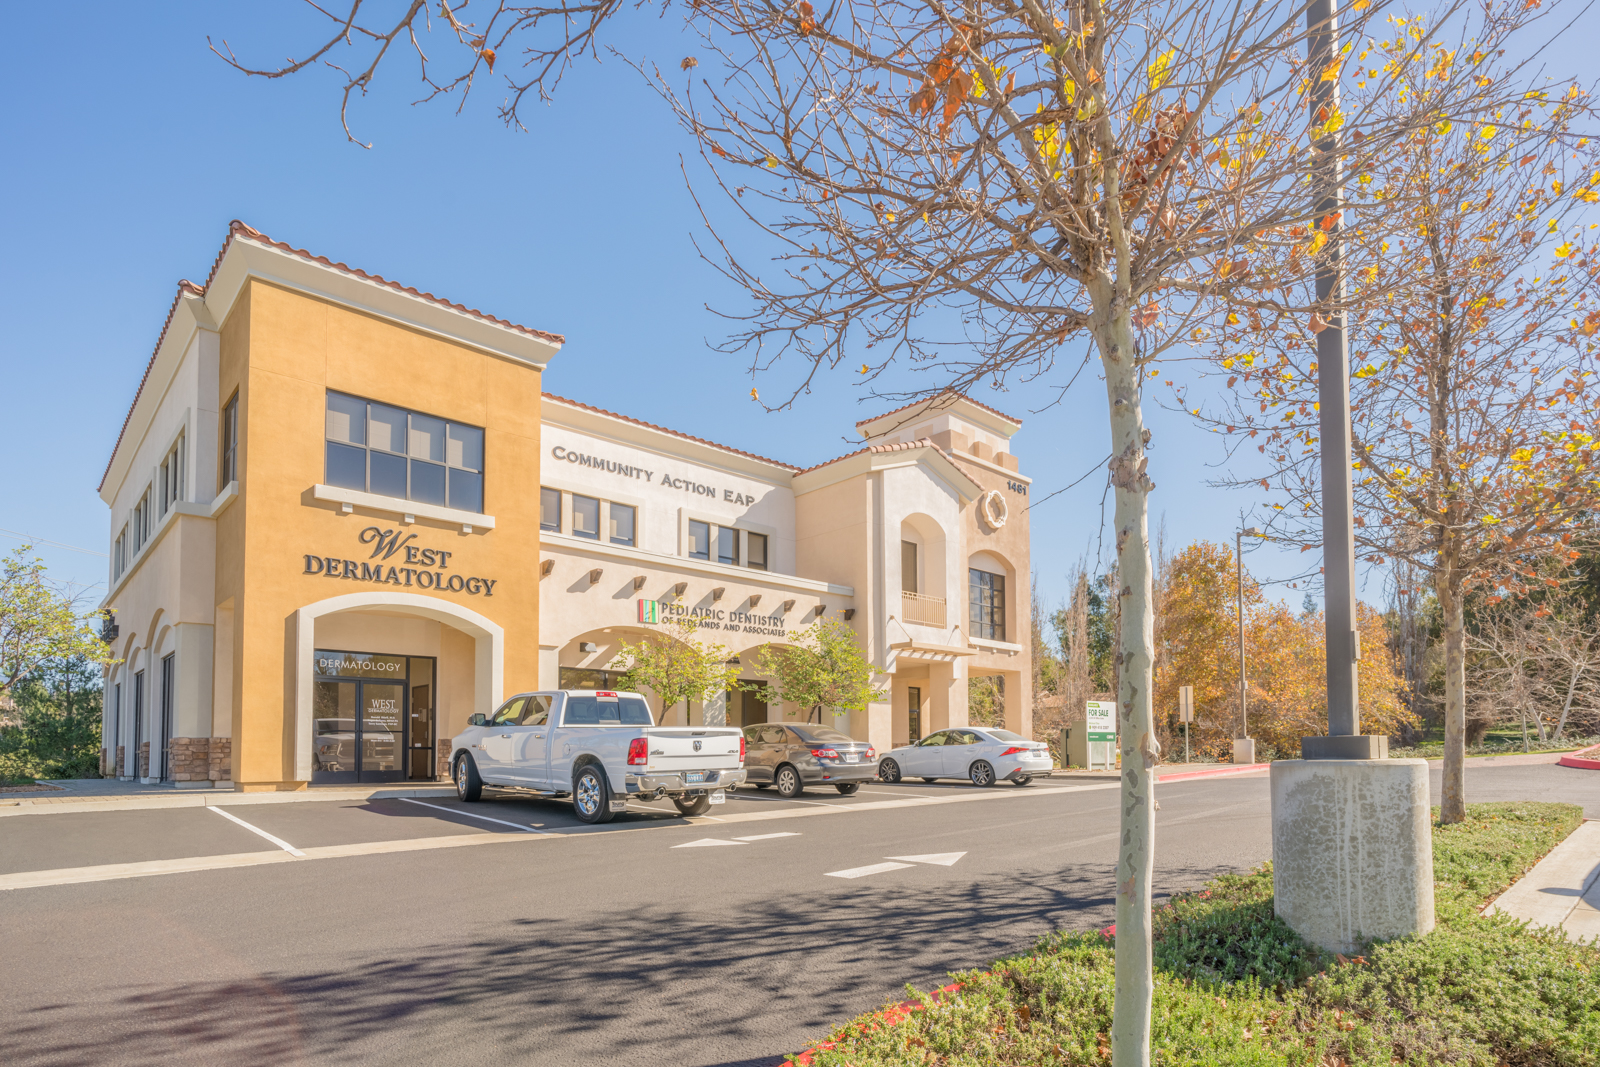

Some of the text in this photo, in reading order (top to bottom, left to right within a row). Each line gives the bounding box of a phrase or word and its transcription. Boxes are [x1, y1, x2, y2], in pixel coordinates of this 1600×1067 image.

[552, 445, 755, 507] COMMUNITY ACTION EAP
[302, 554, 497, 596] DERMATOLOGY
[661, 602, 786, 628] PEDIATRIC DENTISTRY
[661, 616, 674, 625] OF
[723, 623, 741, 632] AND
[742, 626, 786, 637] ASSOCIATES
[319, 658, 401, 672] DERMATOLOGY
[371, 699, 396, 709] WEST
[1088, 709, 1109, 717] FOR SALE
